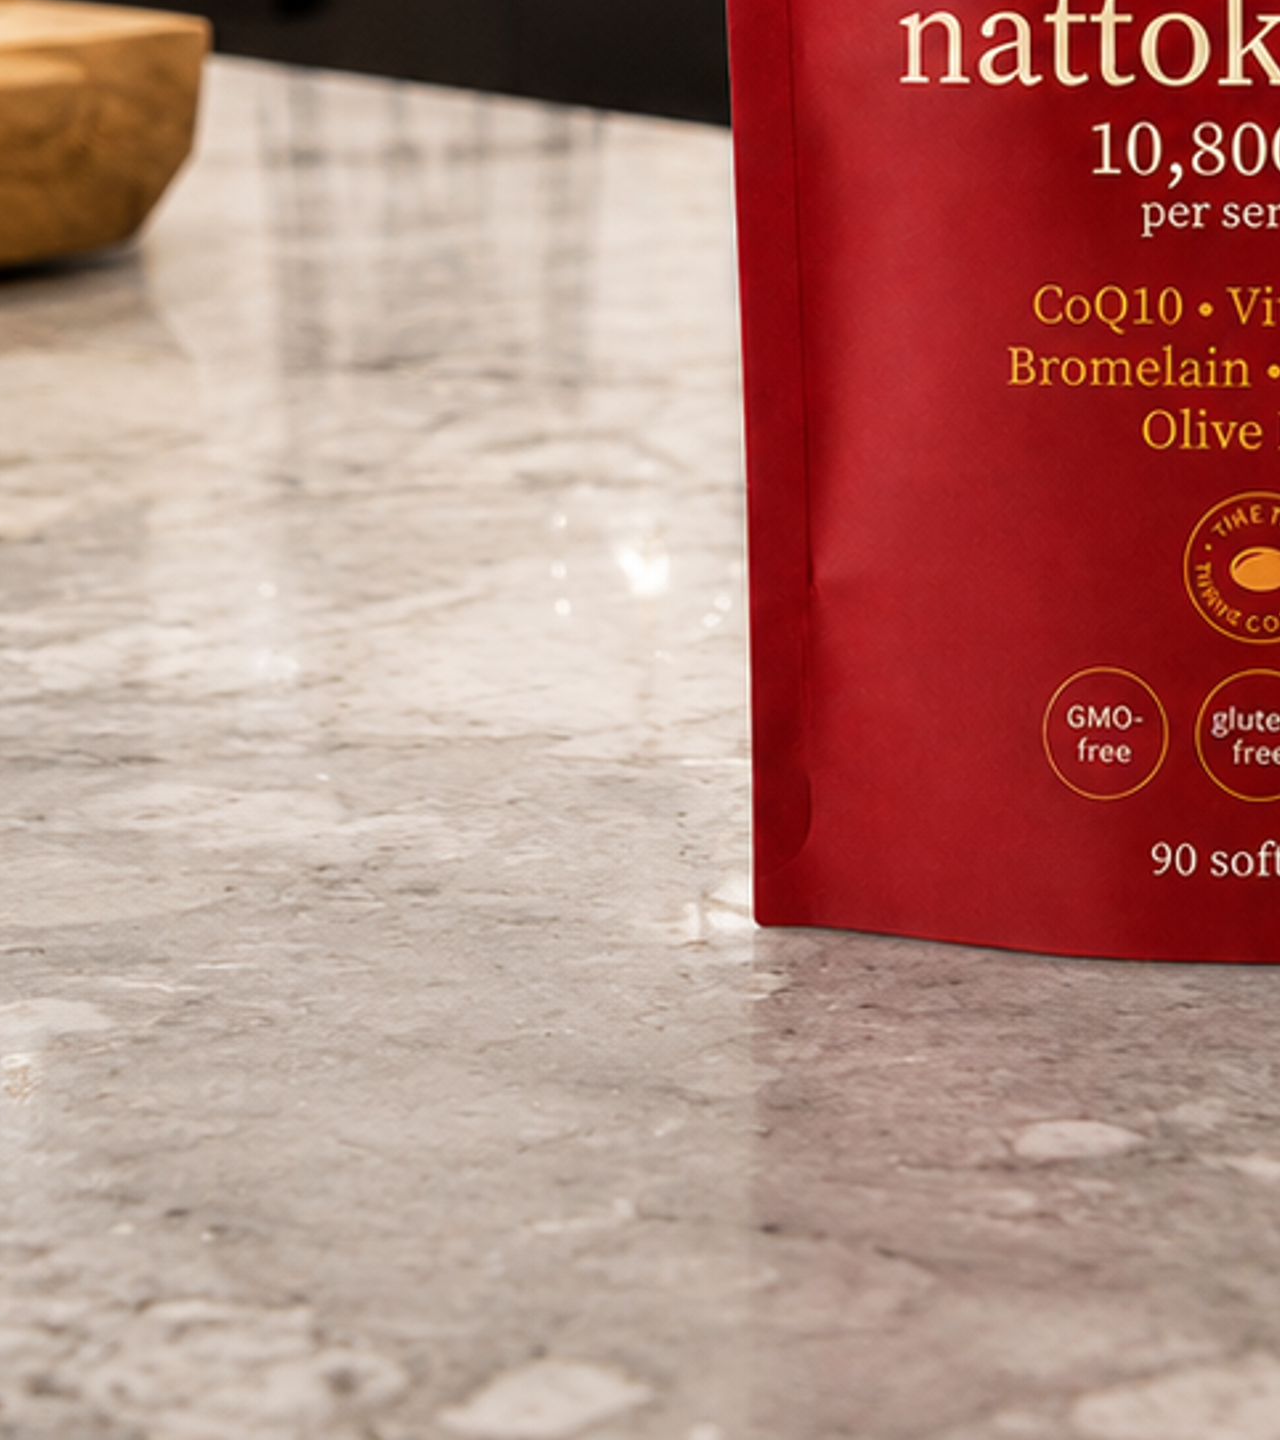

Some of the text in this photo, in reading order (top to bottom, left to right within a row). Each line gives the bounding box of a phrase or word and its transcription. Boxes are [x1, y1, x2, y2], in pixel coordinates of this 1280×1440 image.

[1141, 201, 1211, 238] per
[1033, 285, 1183, 334] CoQ10
[1008, 344, 1249, 387] Bromelain
[1142, 407, 1263, 450] Olive
[1066, 705, 1143, 730] GMO-
[1077, 736, 1132, 763] free
[1151, 842, 1197, 877] 90
